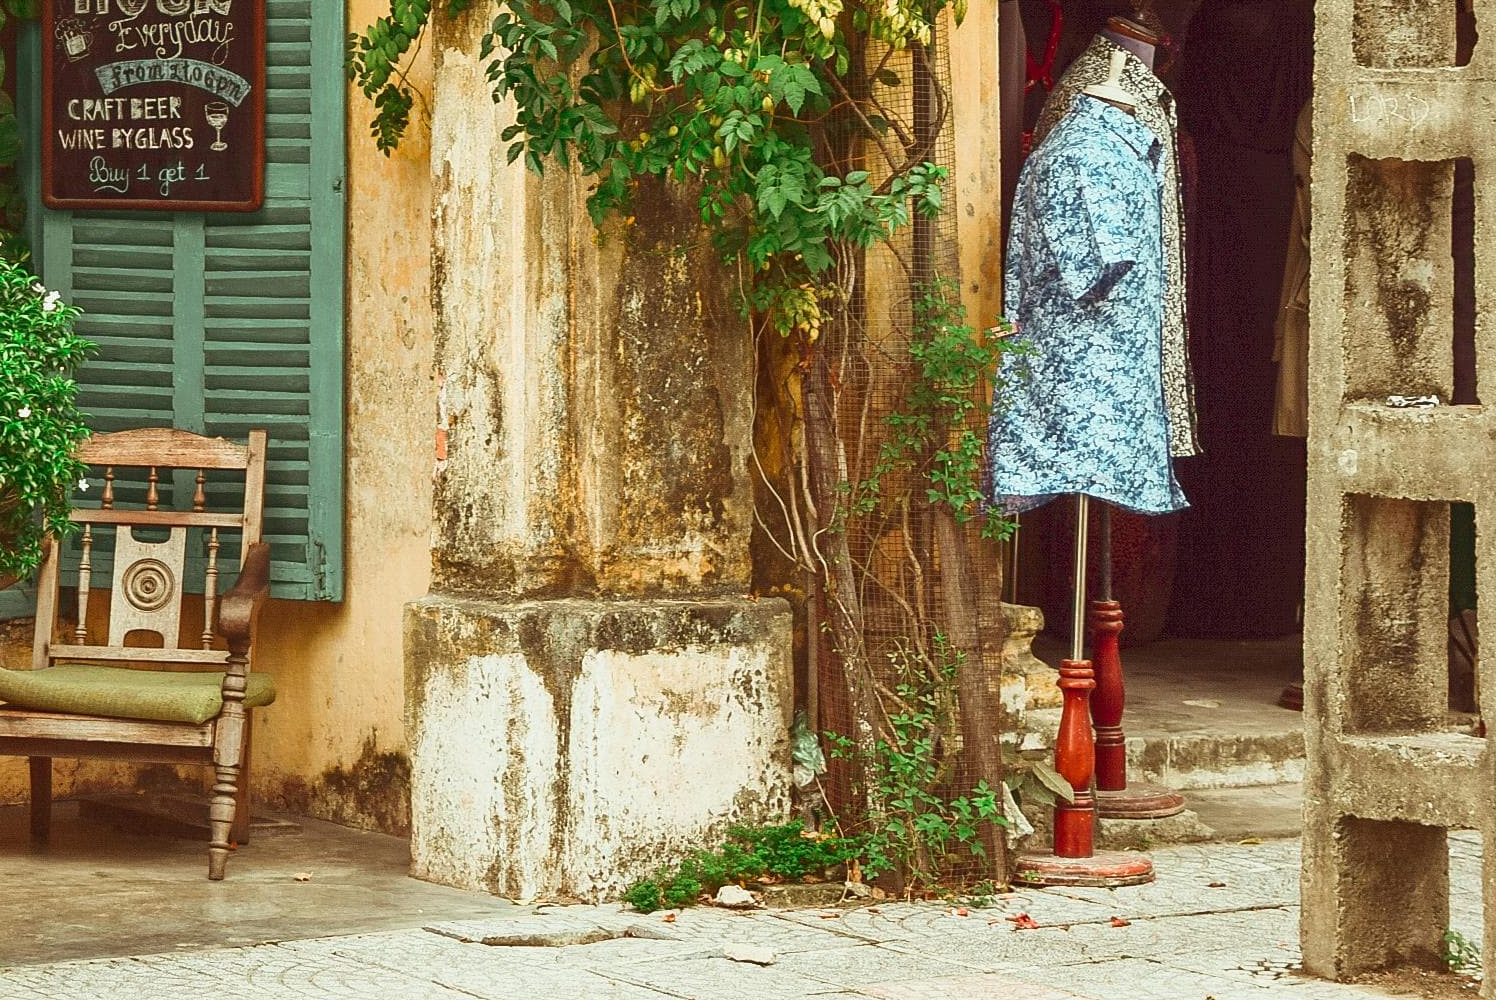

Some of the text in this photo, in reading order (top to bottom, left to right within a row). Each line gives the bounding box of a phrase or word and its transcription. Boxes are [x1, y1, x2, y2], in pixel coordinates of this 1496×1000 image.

[108, 11, 235, 66] Everyday
[111, 63, 165, 87] from
[67, 96, 182, 121] CRAFT BEER
[58, 129, 106, 150] WINE
[89, 155, 210, 196] Buy 1 get 1
